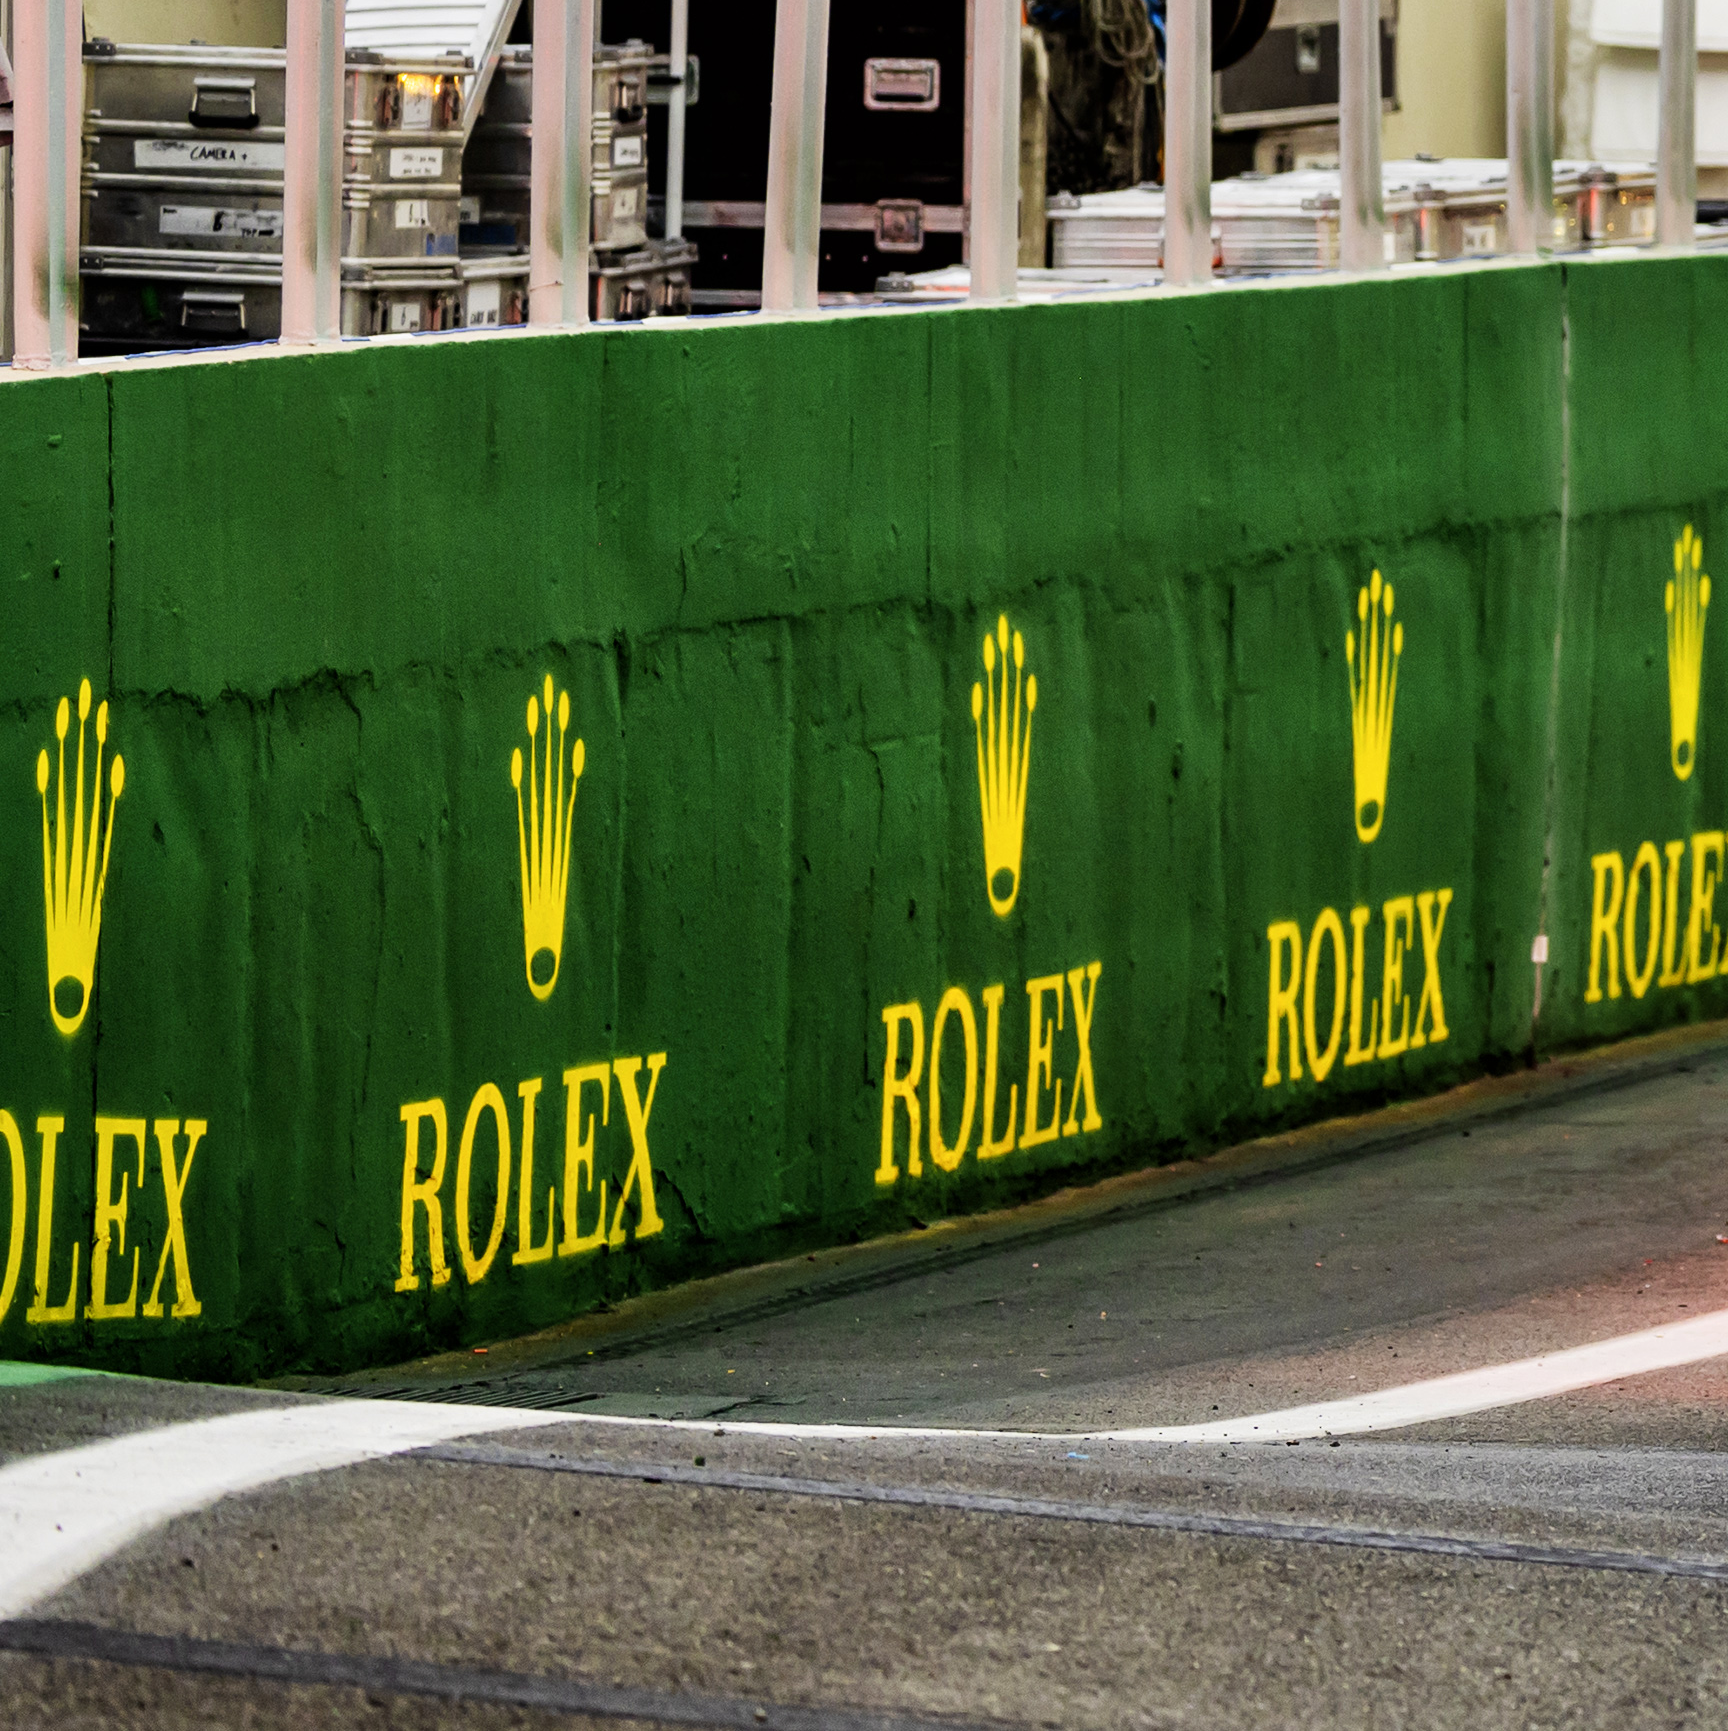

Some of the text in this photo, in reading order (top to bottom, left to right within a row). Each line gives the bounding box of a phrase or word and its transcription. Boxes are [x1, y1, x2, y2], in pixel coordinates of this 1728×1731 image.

[190, 146, 236, 160] CAMERA
[875, 961, 1102, 1185] ROLEX
[1262, 887, 1454, 1087] ROLEX
[395, 1051, 667, 1292] ROLEX
